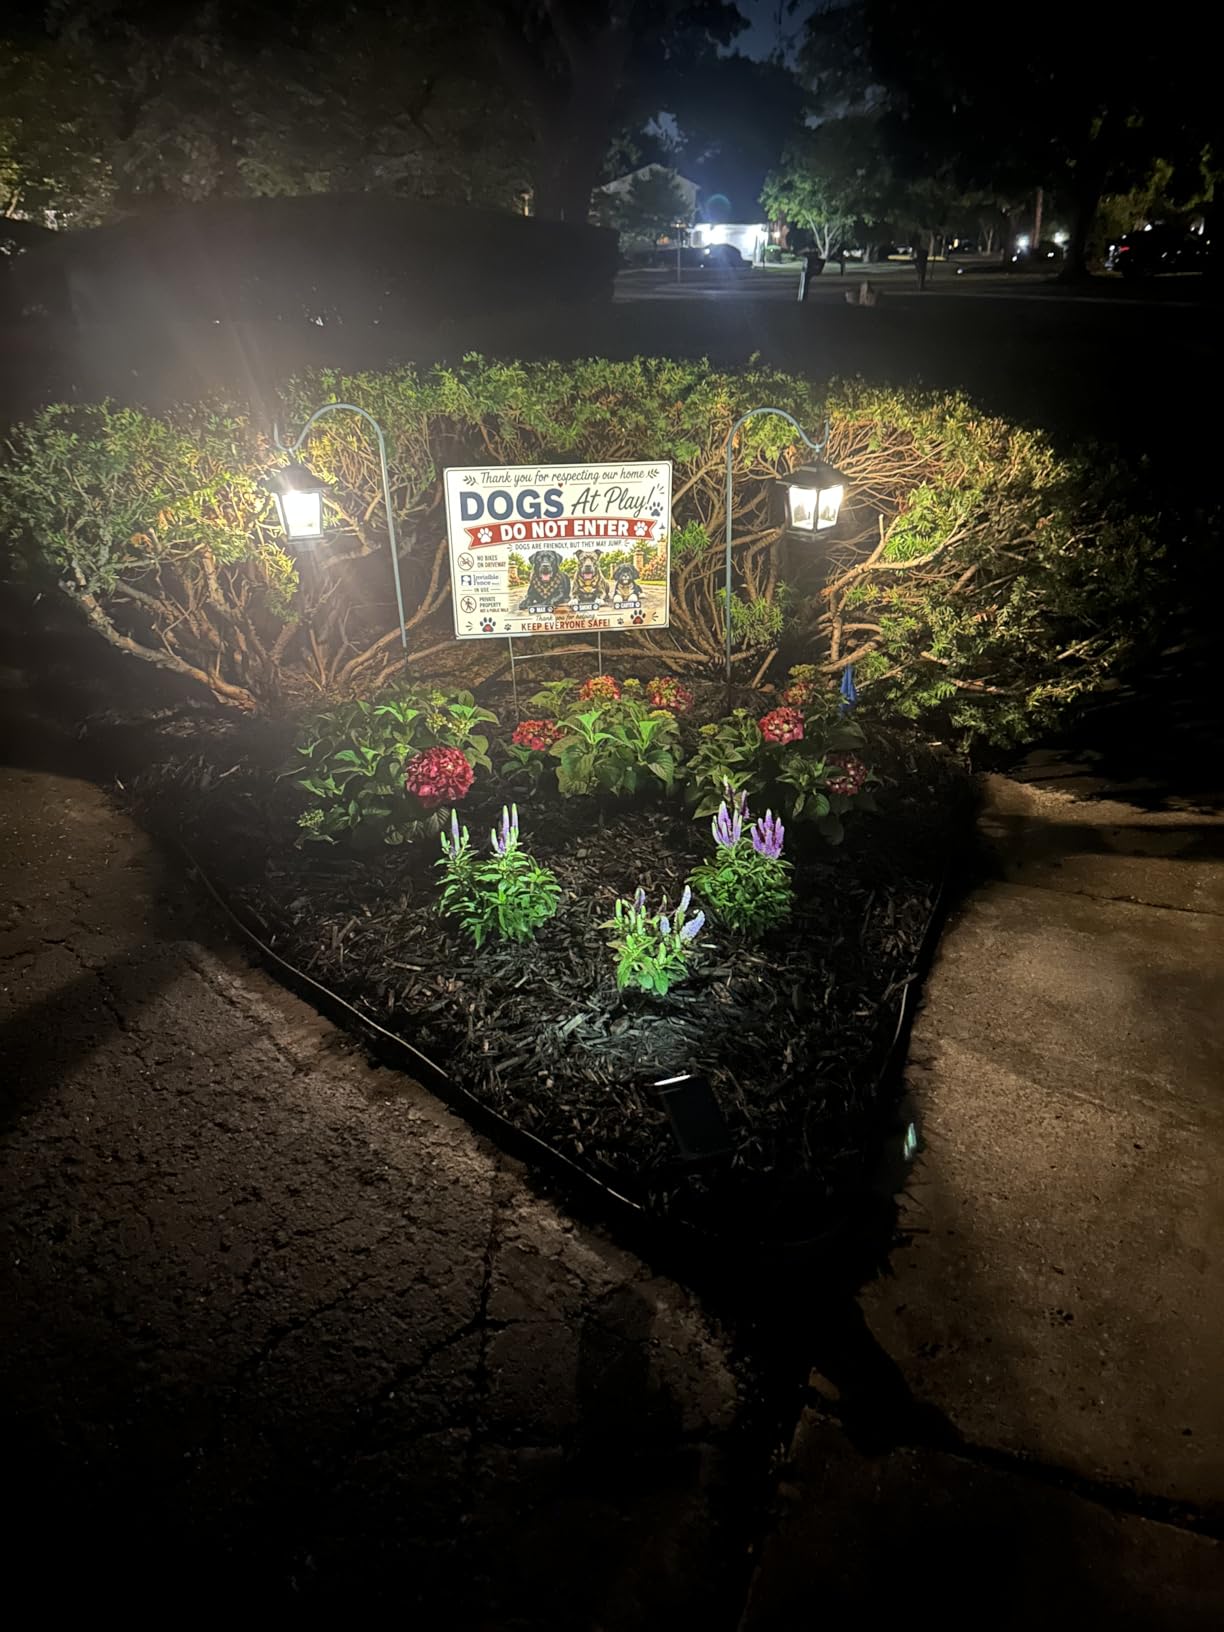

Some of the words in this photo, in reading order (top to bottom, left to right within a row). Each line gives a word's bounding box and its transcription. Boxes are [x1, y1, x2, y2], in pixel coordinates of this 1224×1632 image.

[481, 472, 512, 484] Thank
[514, 474, 532, 487] you
[534, 471, 549, 486] for
[552, 470, 600, 486] respecting
[602, 472, 618, 480] our
[620, 468, 644, 479] home
[459, 488, 564, 522] DOGS
[571, 487, 601, 516] At
[604, 486, 655, 518] Play!
[500, 523, 526, 541] DO
[532, 520, 568, 538] NOT
[574, 520, 628, 536] ENTER
[522, 623, 542, 631] KEEP
[545, 620, 585, 630] EVERYONE
[588, 619, 610, 627] SAFE!
